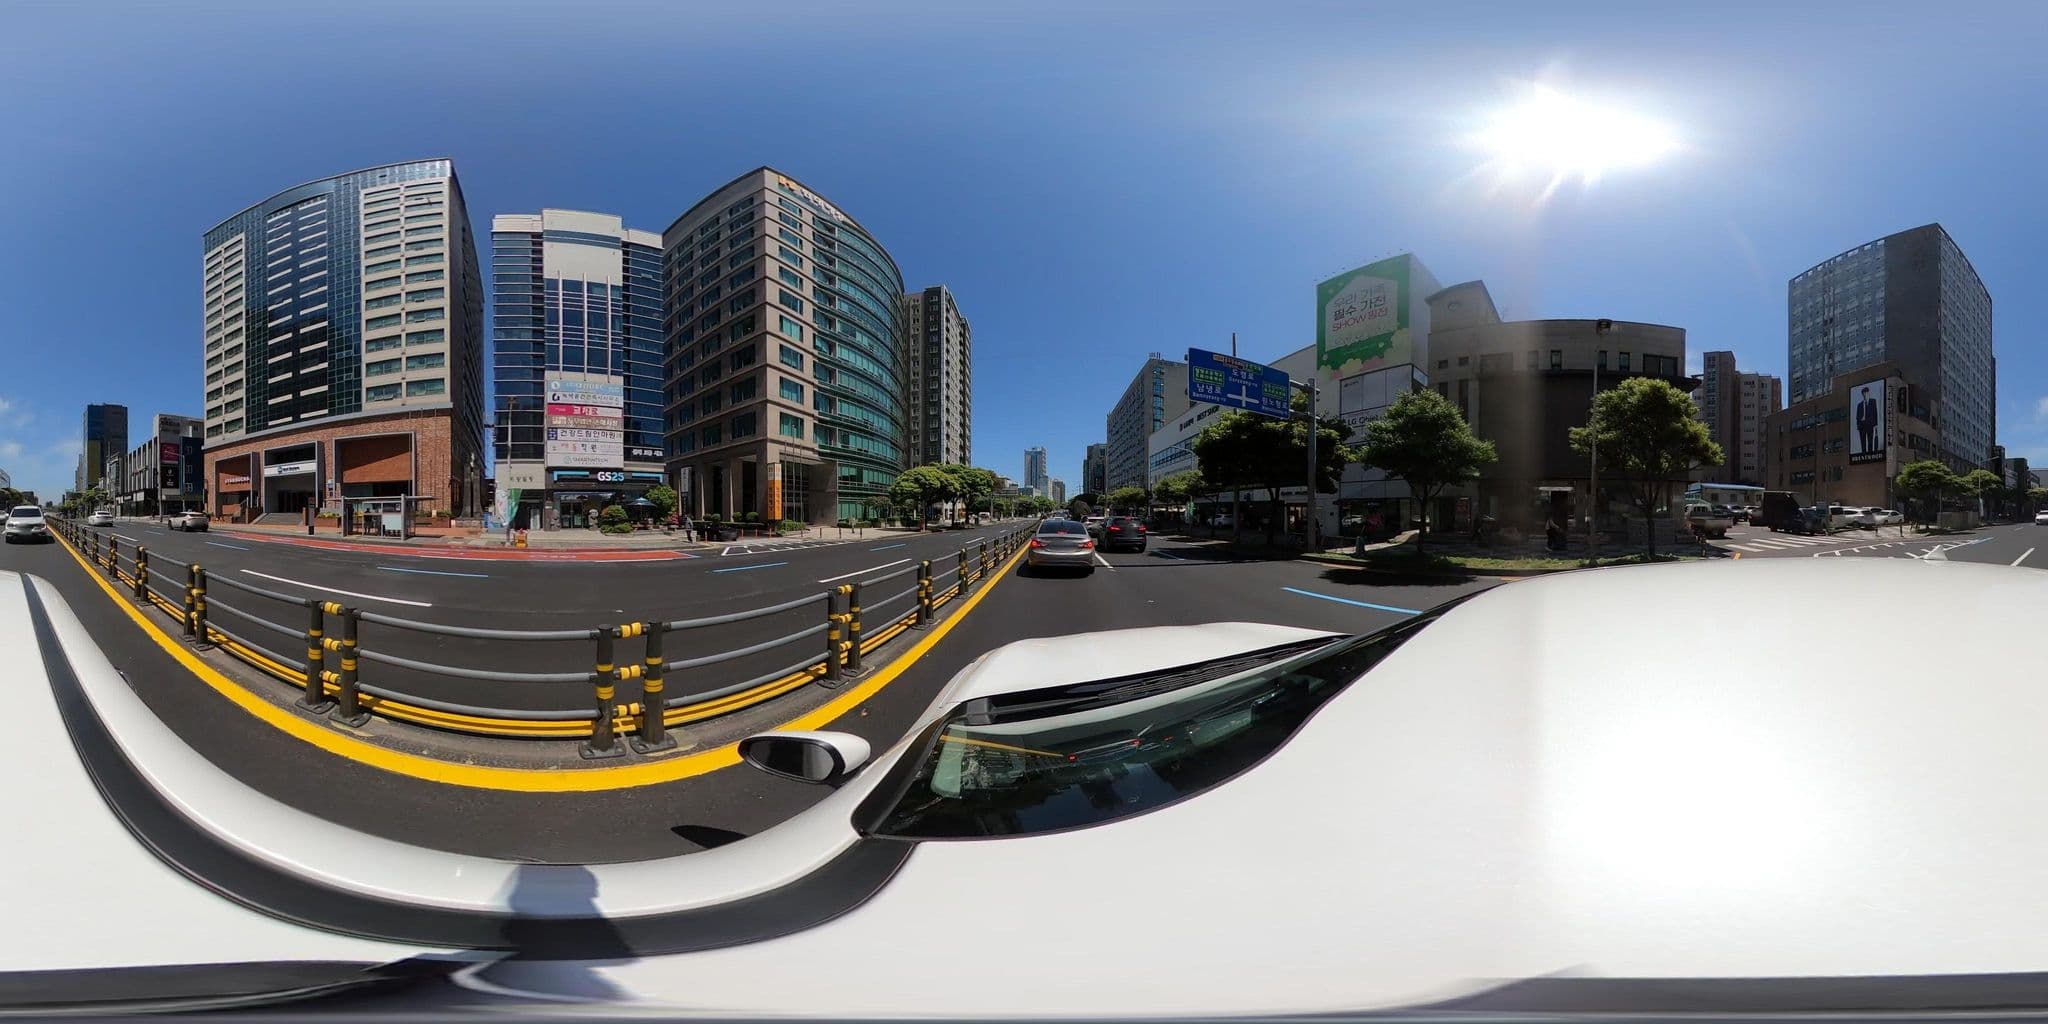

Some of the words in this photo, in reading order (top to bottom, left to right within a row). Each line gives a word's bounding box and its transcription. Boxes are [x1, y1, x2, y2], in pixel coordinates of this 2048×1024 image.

[1334, 305, 1358, 321] 필수
[560, 429, 616, 439] 건강드림안마원
[597, 471, 625, 482] GS25
